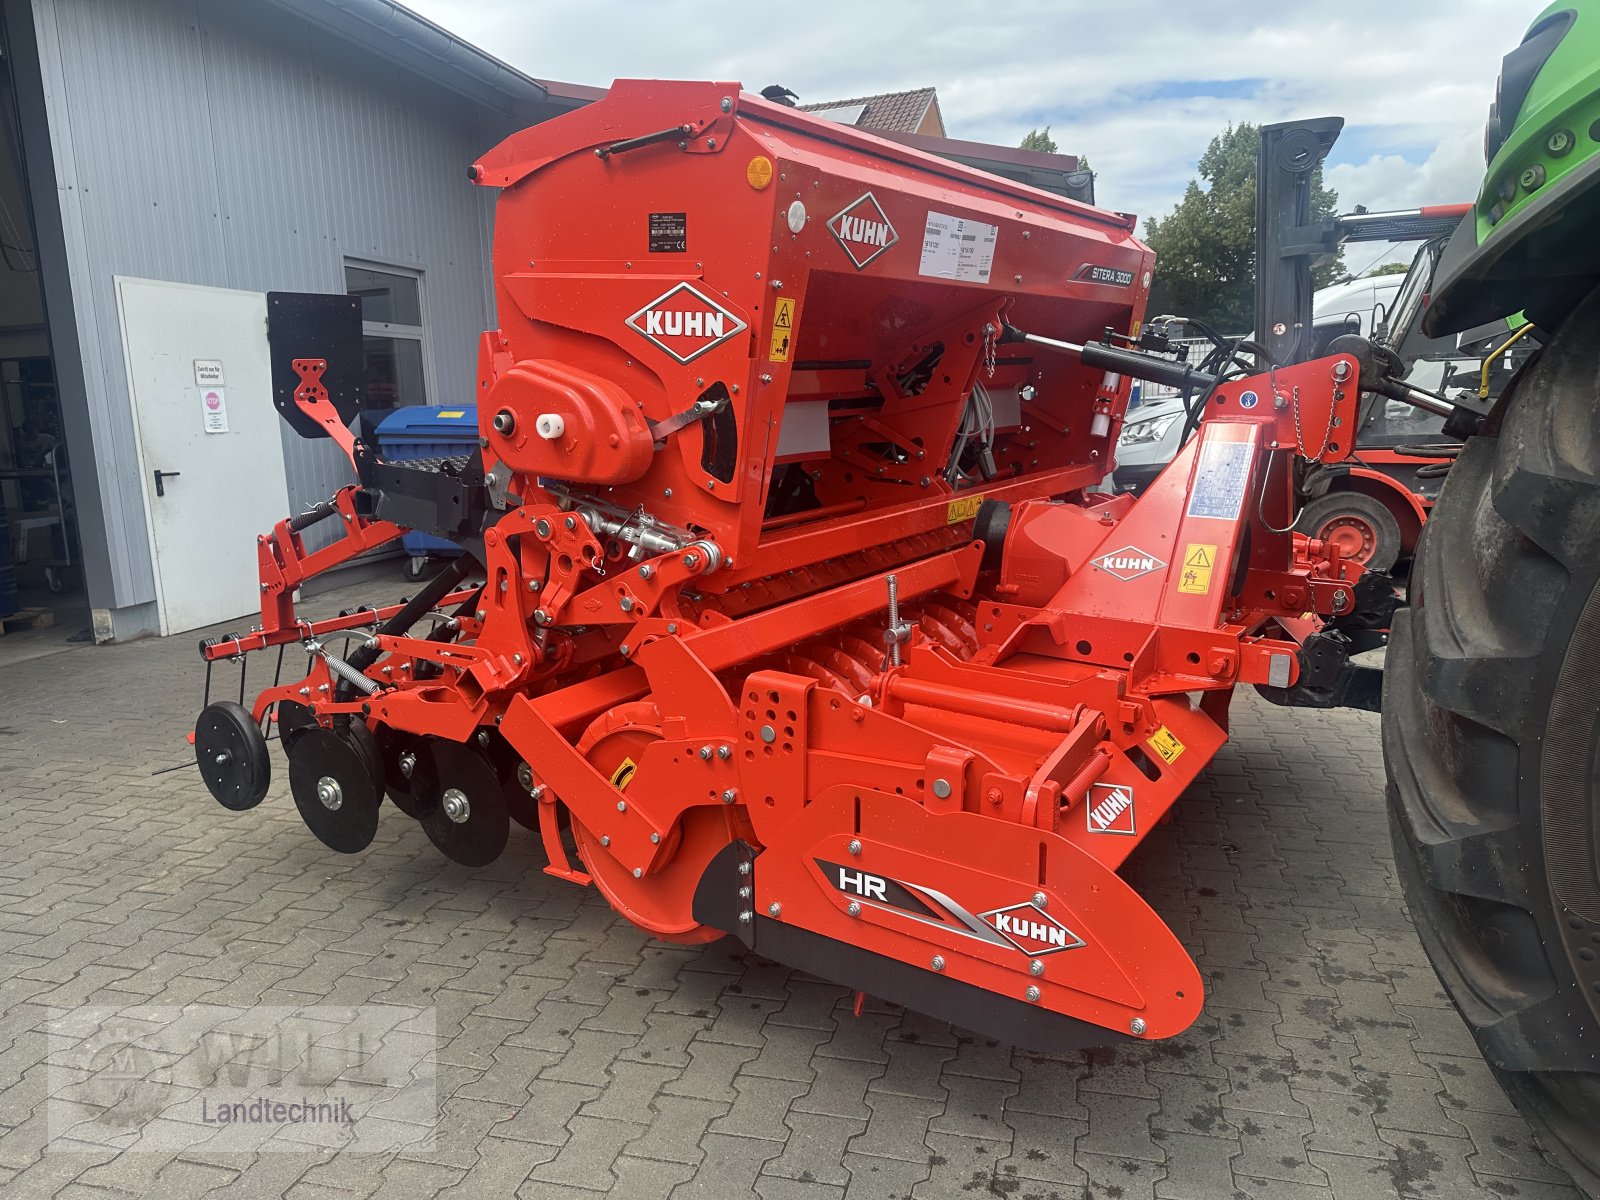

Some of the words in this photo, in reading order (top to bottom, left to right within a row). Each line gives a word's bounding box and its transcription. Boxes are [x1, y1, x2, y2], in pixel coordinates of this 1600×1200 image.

[840, 214, 888, 247] KUHN
[1092, 267, 1115, 281] SITERA
[1116, 271, 1132, 284] 3000
[646, 310, 724, 338] KUHN
[207, 397, 219, 405] STOP
[1103, 557, 1154, 570] KUHN
[1090, 788, 1131, 830] KUHN
[839, 867, 889, 903] HR
[995, 912, 1066, 948] KUHN
